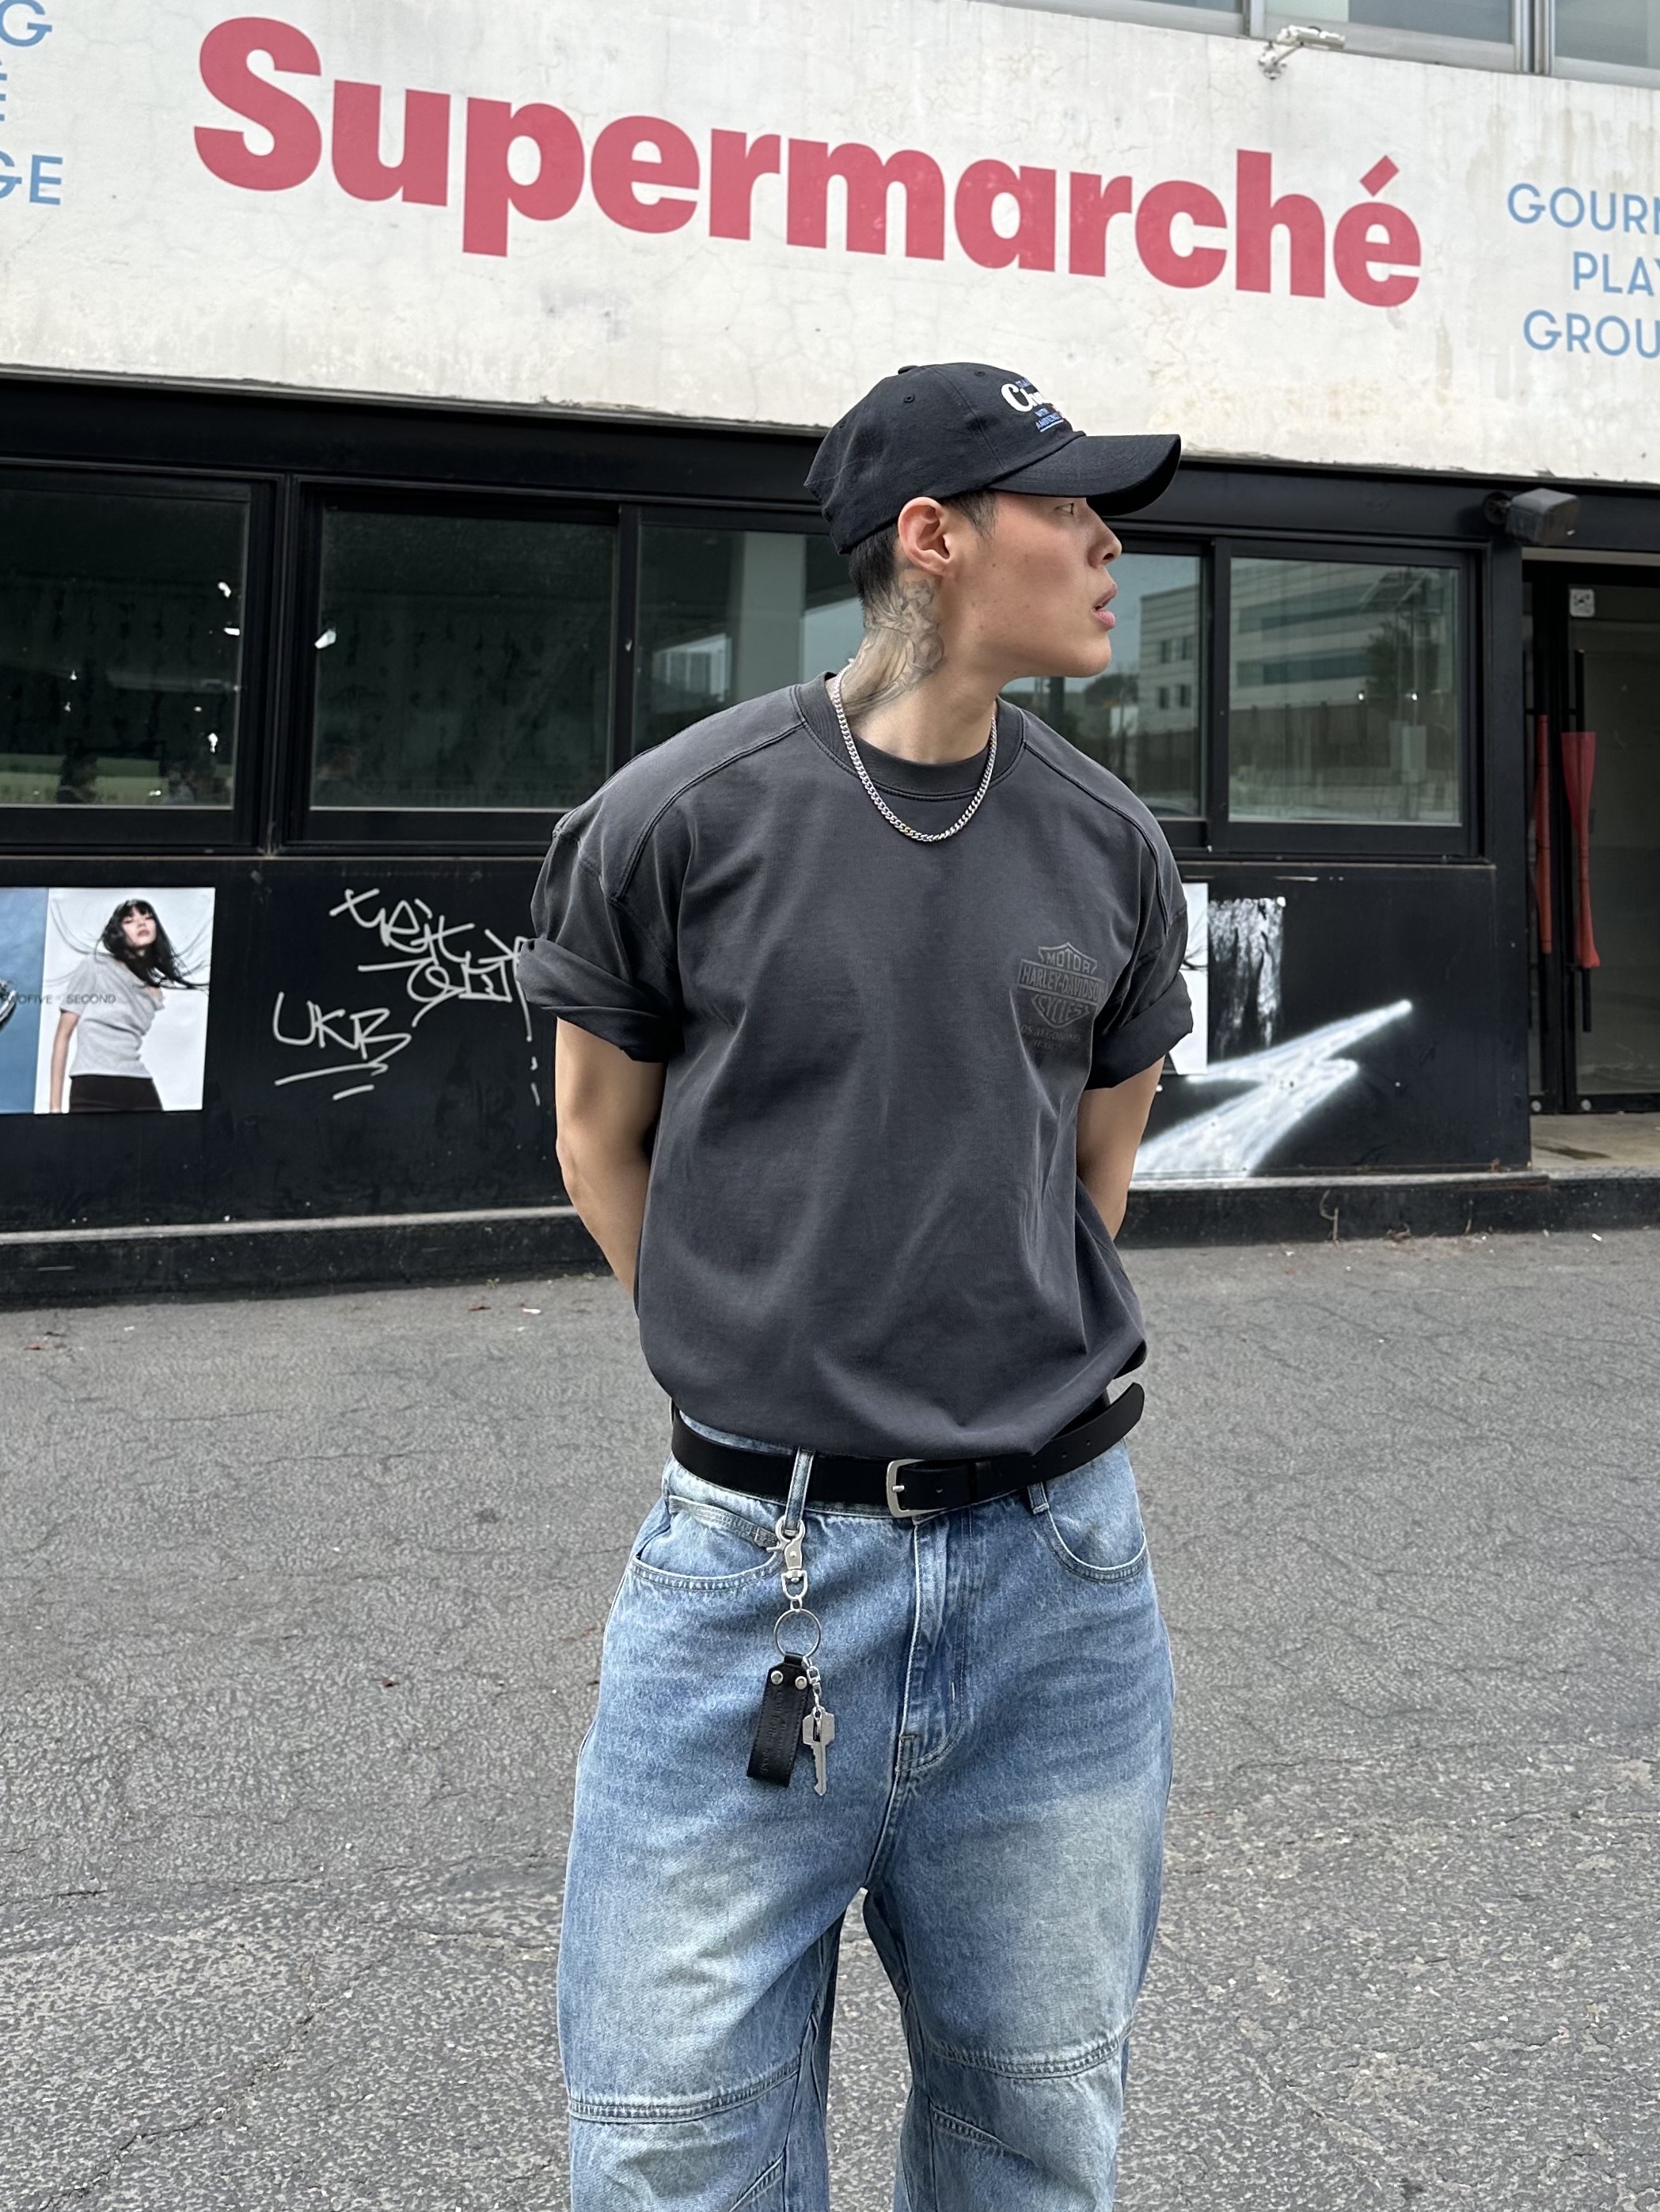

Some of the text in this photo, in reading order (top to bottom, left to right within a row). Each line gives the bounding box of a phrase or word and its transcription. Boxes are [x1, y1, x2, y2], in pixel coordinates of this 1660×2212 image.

[195, 17, 1421, 307] Supermarché
[1507, 183, 1660, 235] GOUR
[1573, 251, 1660, 297] PLA
[1046, 949, 1091, 974] MOTOR
[66, 993, 116, 1005] SECOND
[1021, 963, 1108, 1001] HARLEY-DAVIDSON
[1038, 995, 1084, 1024] CYCLES
